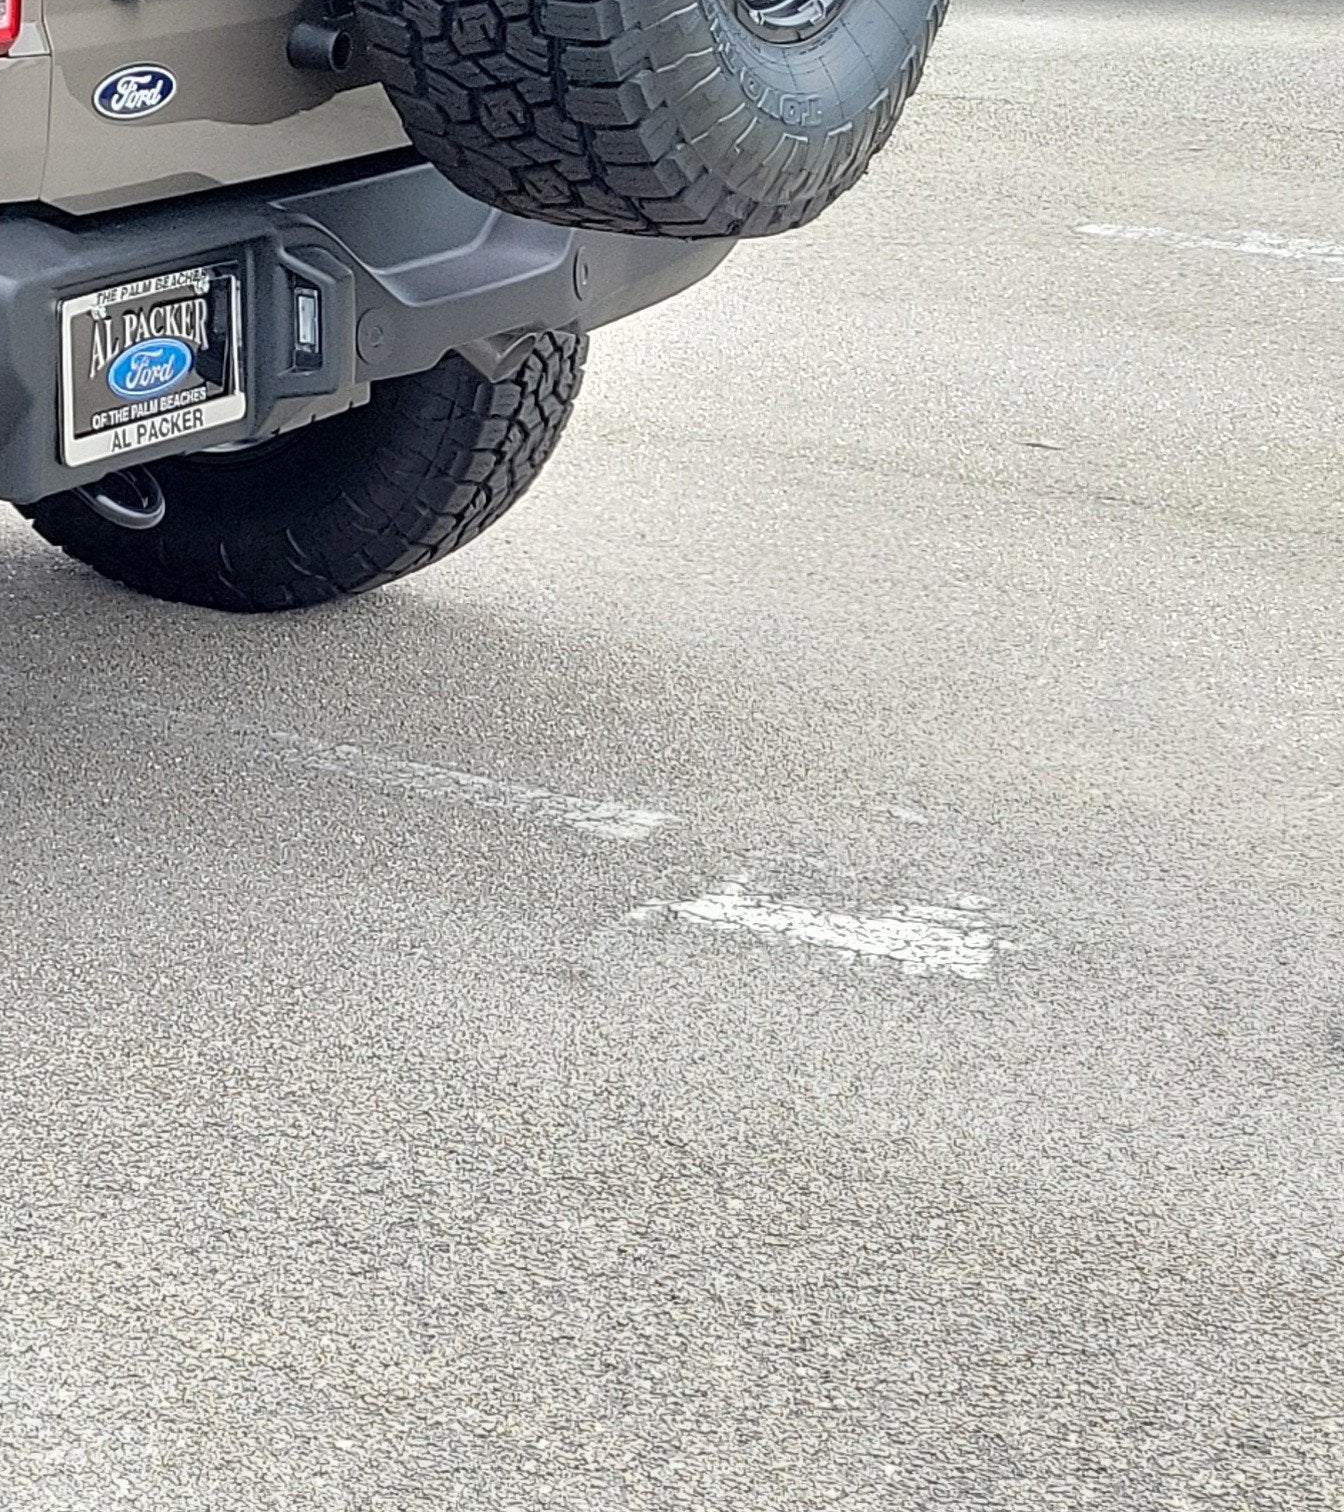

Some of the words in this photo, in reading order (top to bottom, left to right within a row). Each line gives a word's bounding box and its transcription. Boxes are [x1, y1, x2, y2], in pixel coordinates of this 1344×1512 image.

[110, 74, 164, 111] Ford
[95, 288, 119, 305] THE
[121, 281, 153, 300] PALM
[154, 268, 208, 292] BEACHES
[89, 319, 119, 379] AL
[122, 298, 209, 351] PACKER
[125, 348, 175, 390] Ford
[92, 412, 110, 431] OF
[108, 406, 130, 424] THE
[130, 400, 158, 420] PALM
[160, 386, 207, 412] BEACHES
[111, 430, 132, 453] AL
[136, 408, 205, 445] PACKER
